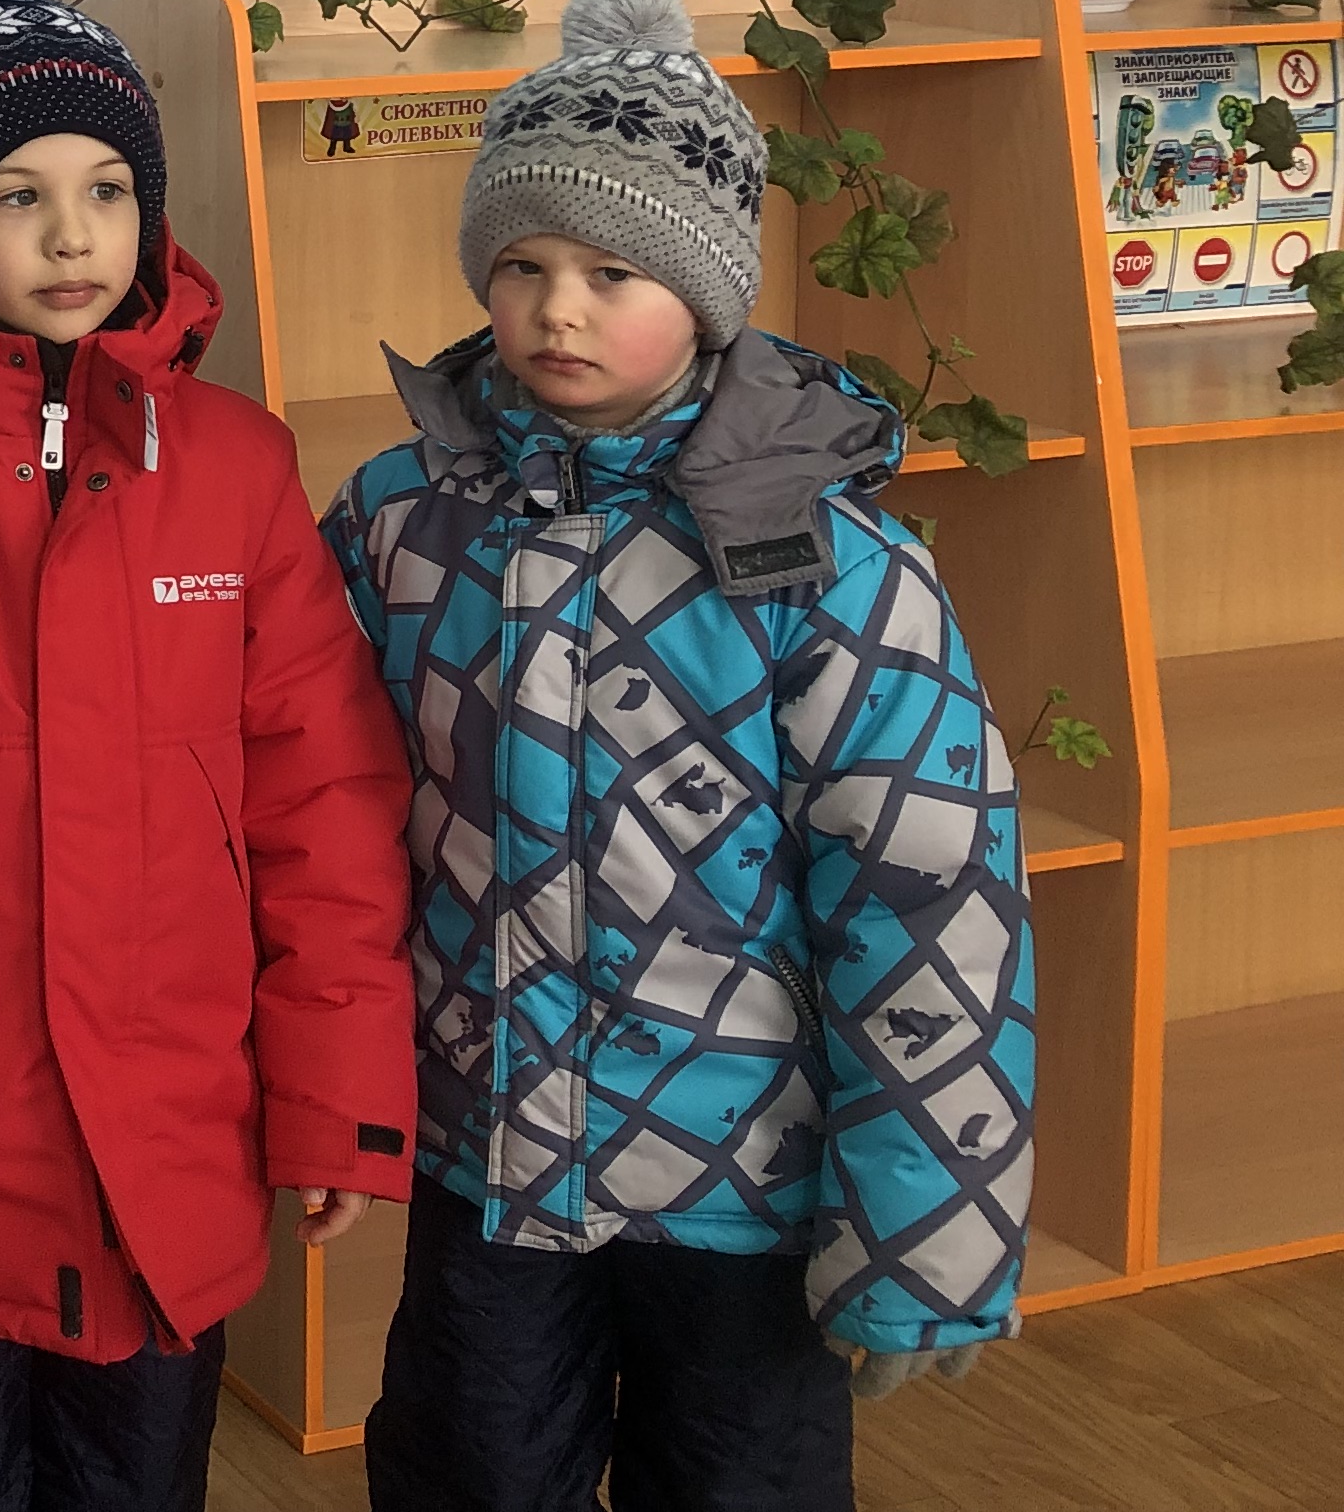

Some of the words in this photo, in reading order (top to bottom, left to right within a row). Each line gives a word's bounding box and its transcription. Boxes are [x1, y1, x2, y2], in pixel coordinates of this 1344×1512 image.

[1114, 56, 1154, 69] ЗНАКИ
[1158, 52, 1236, 67] ПРИОРИТЕТА
[1122, 72, 1131, 84] И
[1134, 68, 1232, 84] ЗАПРЕЩАЮЩИЕ
[1158, 86, 1198, 99] ЗНАКИ
[380, 99, 488, 121] СЮЖЕТНО
[366, 122, 464, 146] РОЛЕВЫХ
[1116, 256, 1153, 272] STOP
